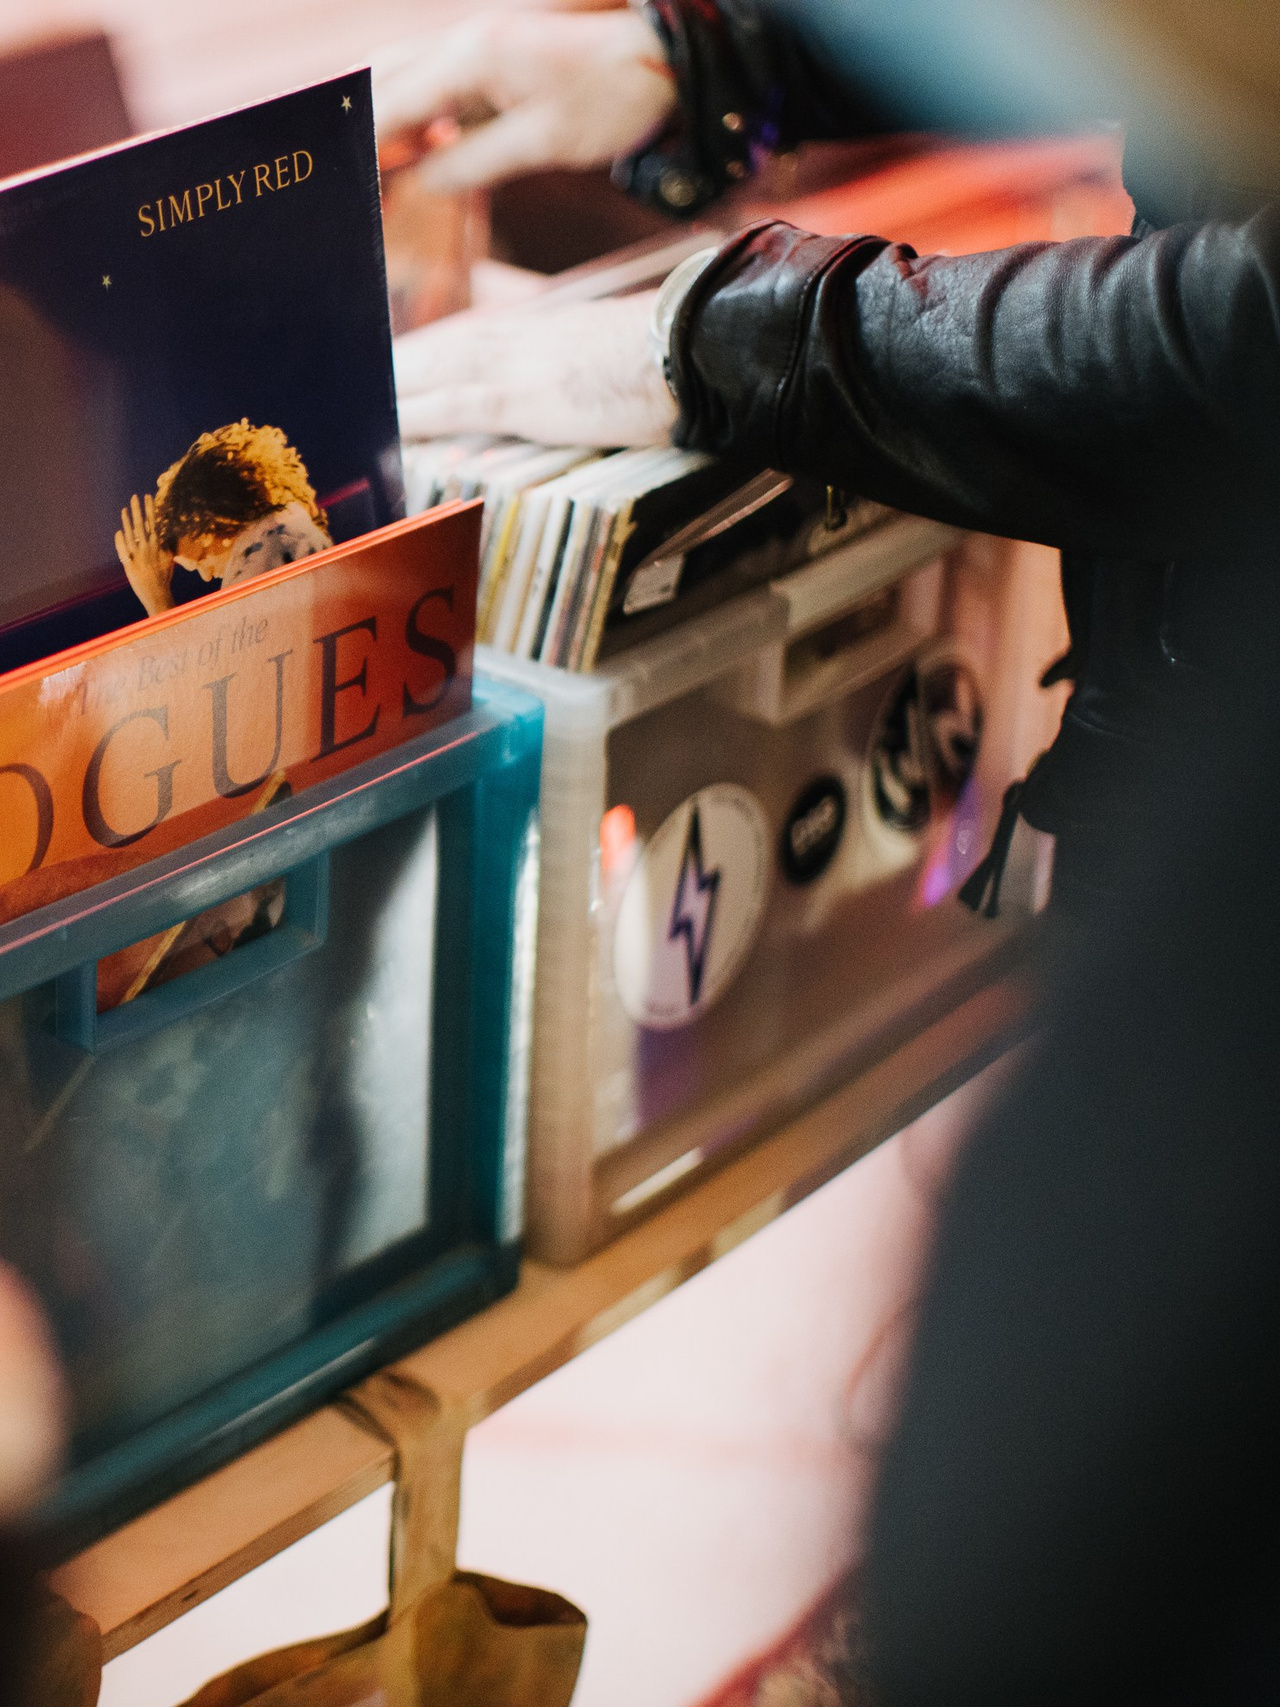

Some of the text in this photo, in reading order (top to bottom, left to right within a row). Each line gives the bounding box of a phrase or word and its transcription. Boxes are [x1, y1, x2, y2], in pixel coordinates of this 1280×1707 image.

[137, 149, 314, 237] SIMPLY RED
[198, 628, 226, 671] of
[230, 615, 269, 654] the
